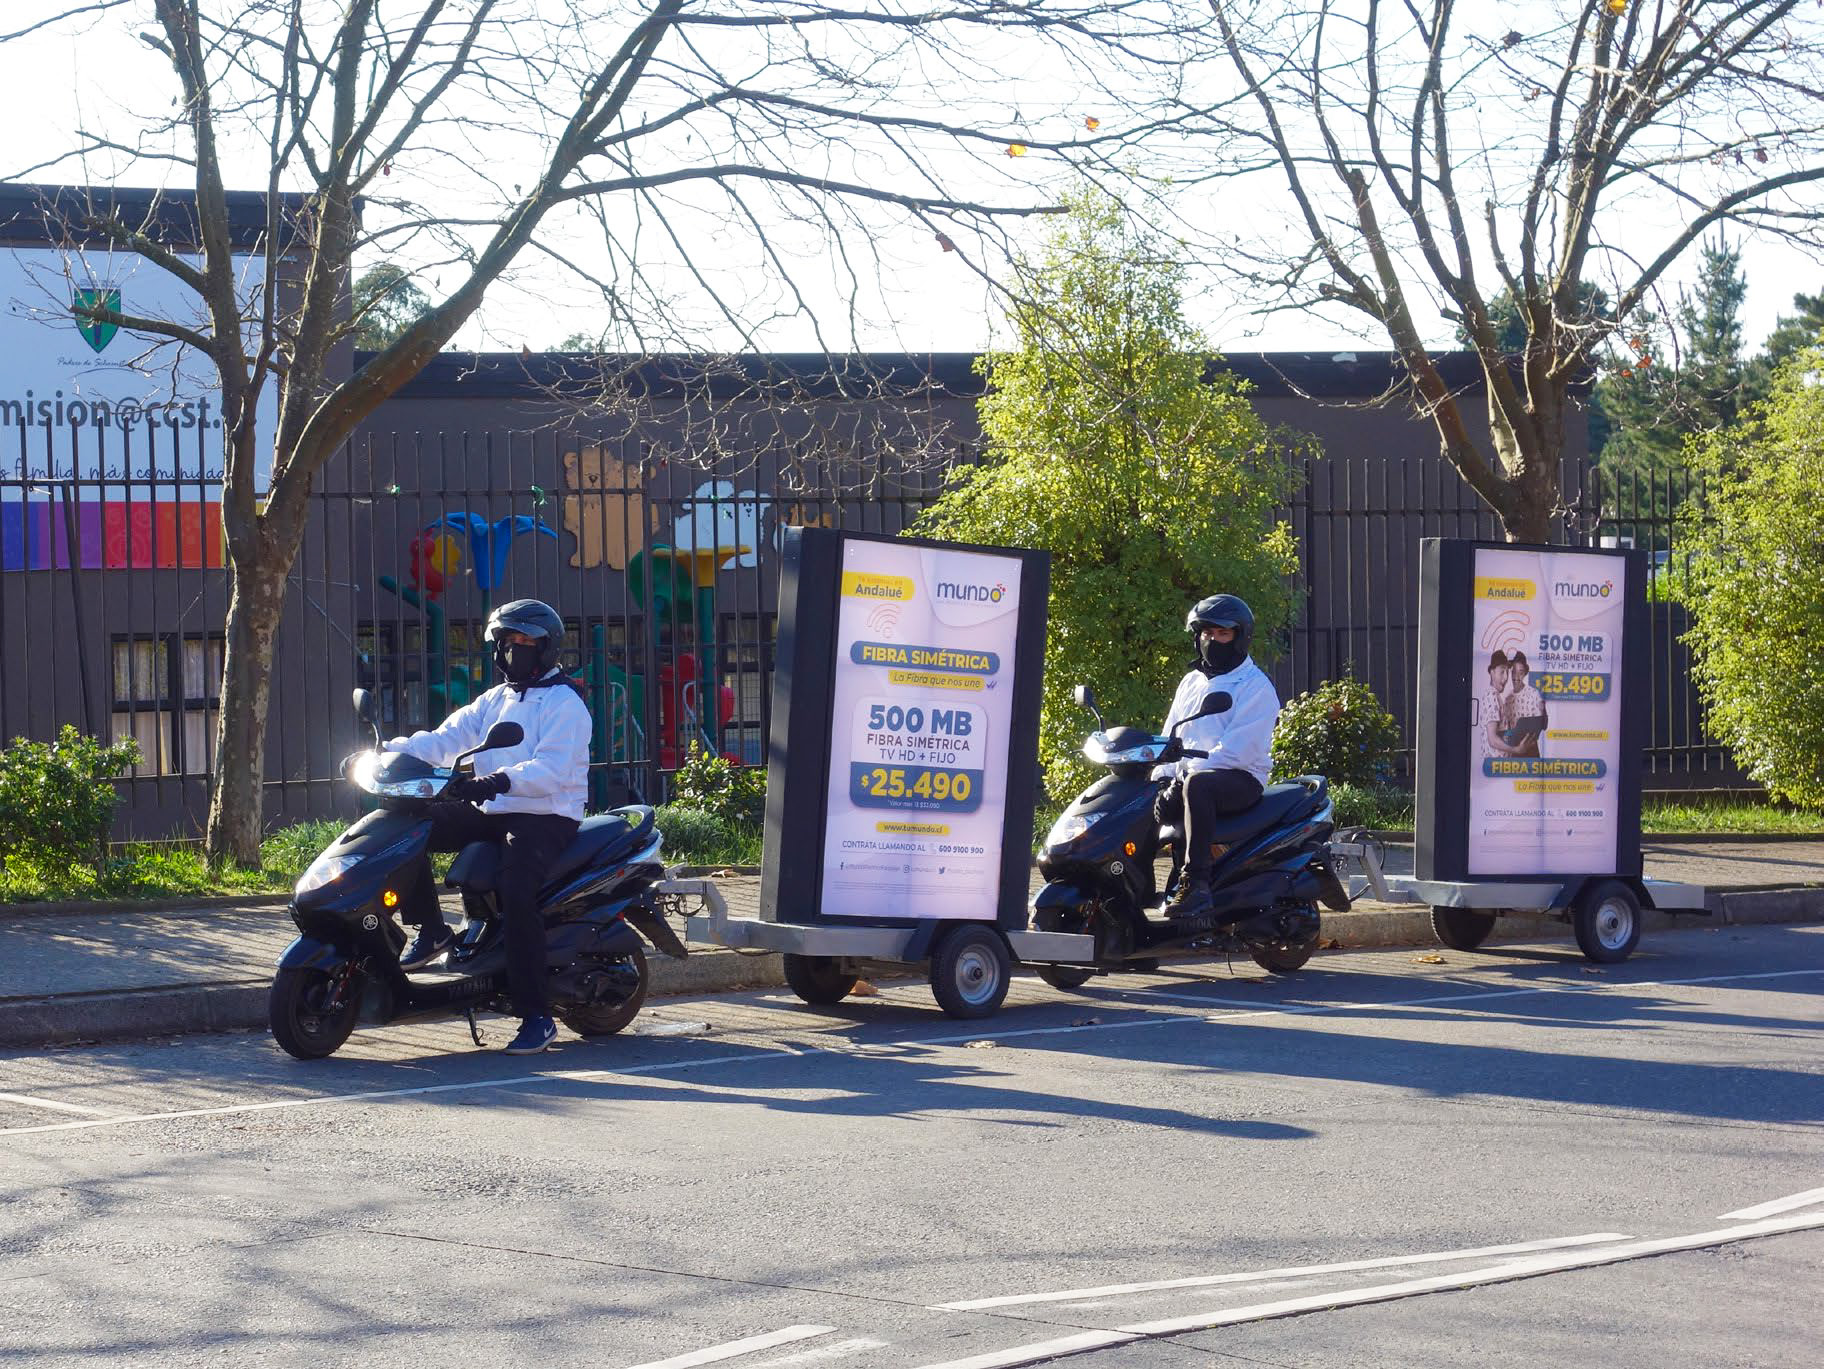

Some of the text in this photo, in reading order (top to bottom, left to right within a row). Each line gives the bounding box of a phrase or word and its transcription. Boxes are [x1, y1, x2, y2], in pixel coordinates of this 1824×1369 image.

[0, 389, 224, 431] mision@ccst.
[855, 584, 902, 598] Andalué
[1538, 634, 1603, 652] 500 MB
[863, 646, 990, 670] FIBRA SIMÉTRICA
[1538, 653, 1561, 661] FIBRA
[1558, 662, 1568, 670] HD
[1577, 663, 1594, 671] FIJO
[894, 672, 980, 688] La Fibra que nos une
[867, 704, 972, 736] 500 MB
[867, 733, 970, 751] FIBRA SIMÉTRICA
[880, 749, 956, 764] TV HD + FIJO
[1491, 760, 1598, 775] FIBRA SIMÉTRICA
[861, 768, 971, 801] $25.490
[884, 824, 943, 833] www.tumundo.cl
[842, 840, 876, 850] CONTRATA
[878, 841, 916, 851] LLAMANDO
[917, 844, 926, 852] AL
[939, 844, 952, 853] 600
[970, 846, 984, 854] 900
